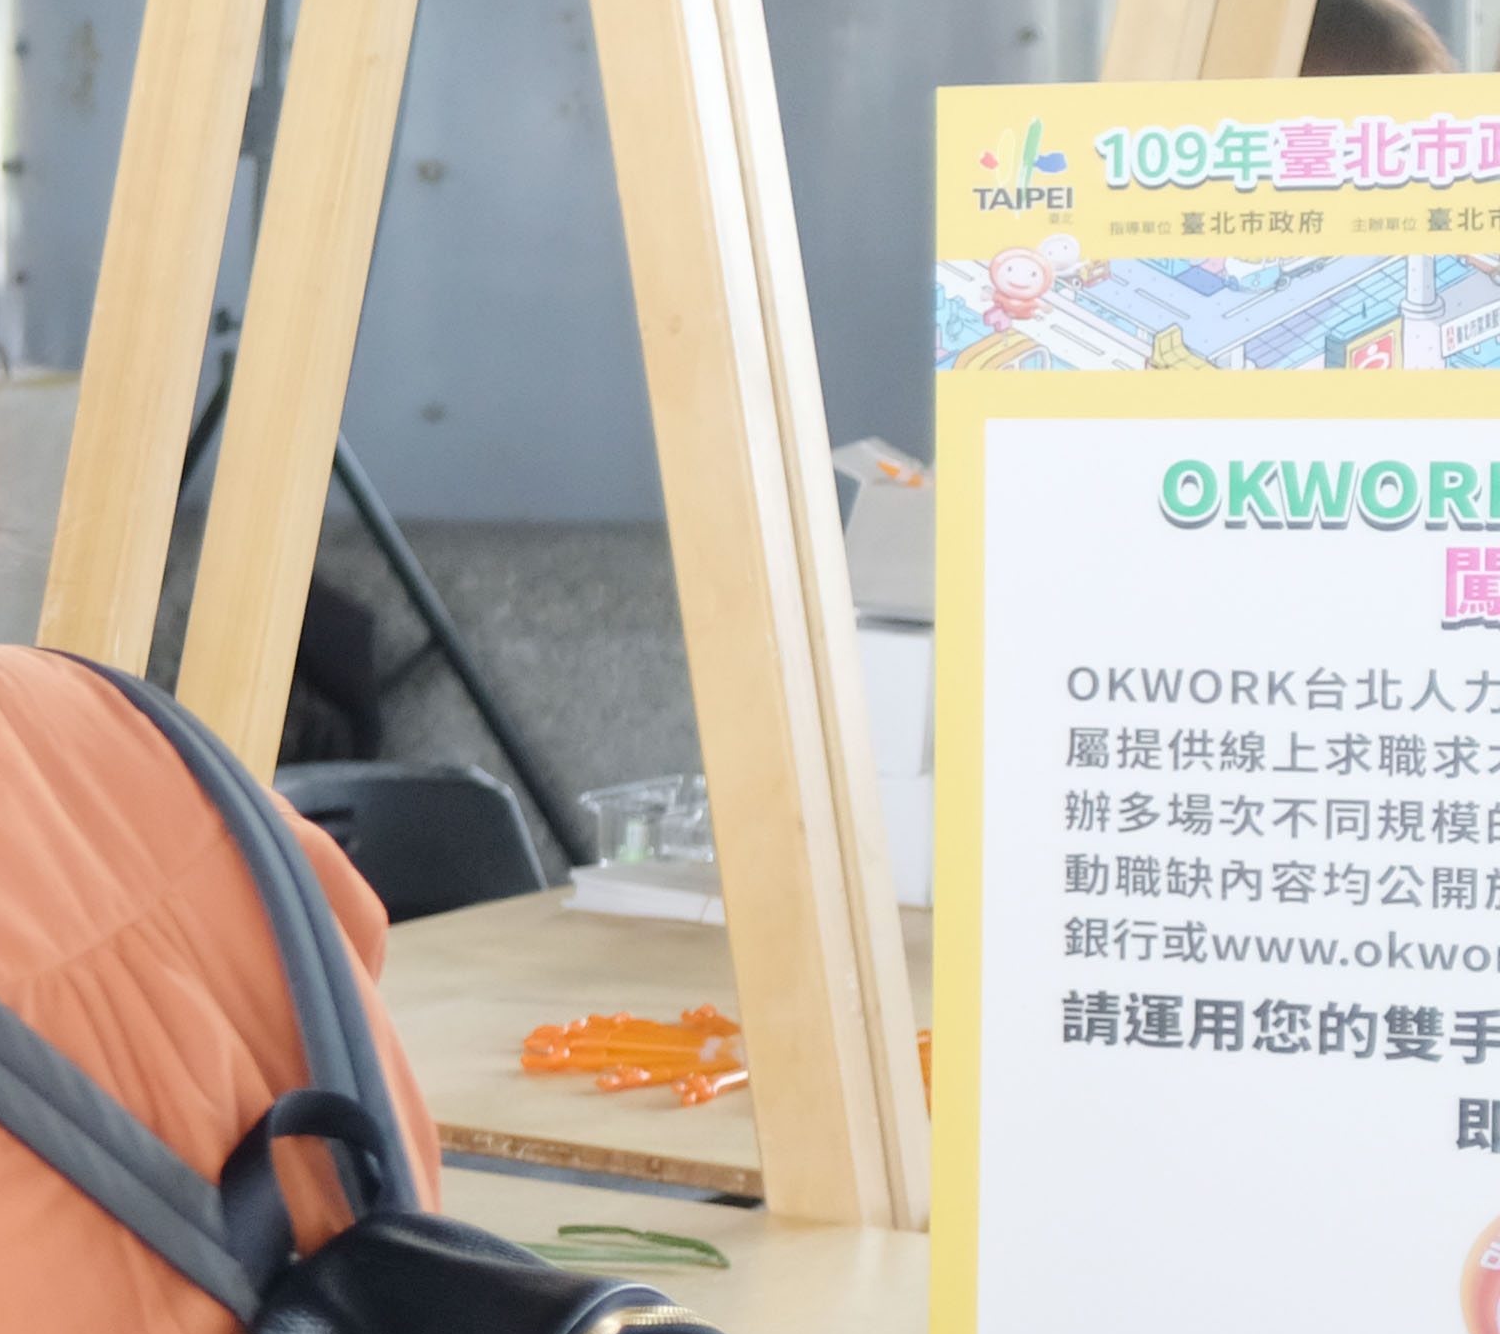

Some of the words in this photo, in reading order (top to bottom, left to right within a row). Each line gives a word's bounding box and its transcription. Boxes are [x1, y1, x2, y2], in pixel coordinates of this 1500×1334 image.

[973, 186, 1075, 212] TAIPEI
[1180, 209, 1326, 236] 臺北市政府
[1160, 460, 1500, 525] OKWOR
[1064, 726, 1500, 780] 屬提供線上求職求
[1064, 789, 1500, 845] 辦多場次不同規模
[1063, 916, 1500, 973] 銀行或www.okwo
